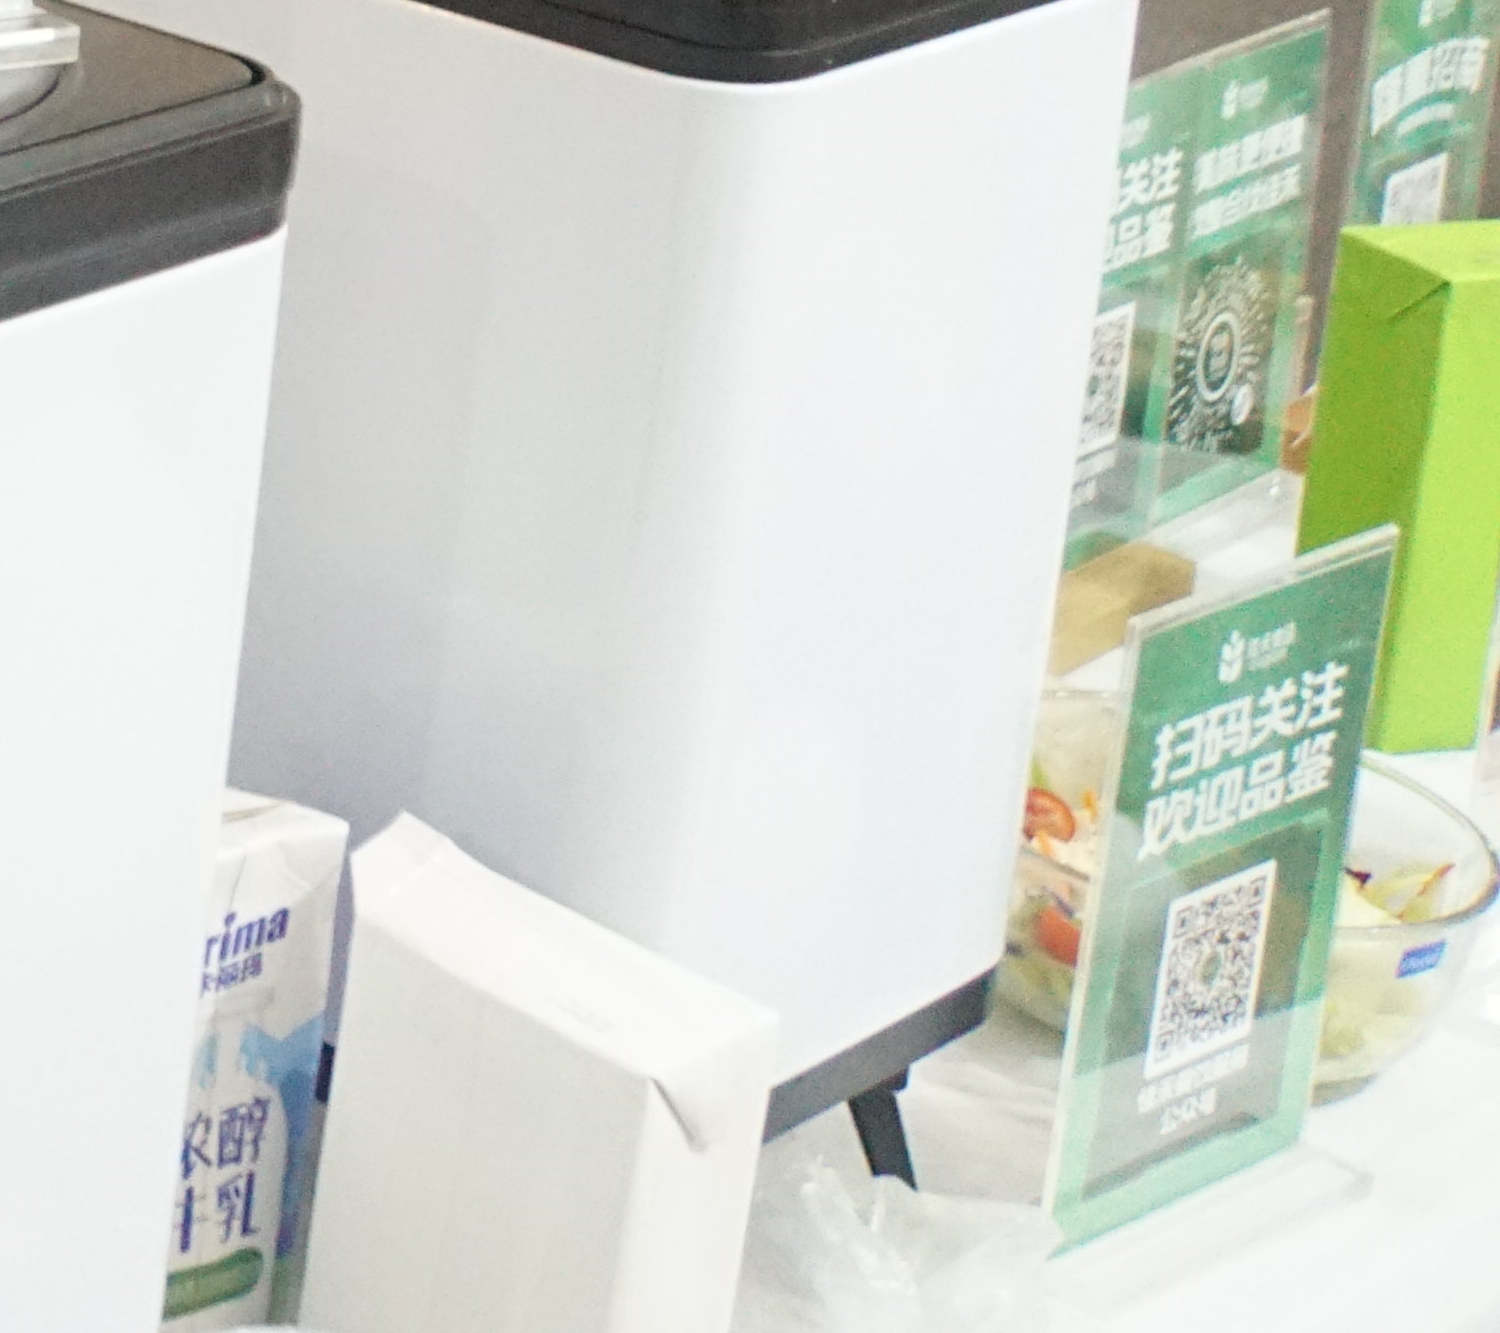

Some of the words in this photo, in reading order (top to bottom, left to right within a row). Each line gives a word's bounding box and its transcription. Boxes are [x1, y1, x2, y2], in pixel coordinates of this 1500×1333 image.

[1115, 146, 1185, 215] 关注
[1103, 202, 1177, 272] 品鉴
[1150, 659, 1349, 791] 扫码关注
[1137, 730, 1338, 862] 欢迎品鉴
